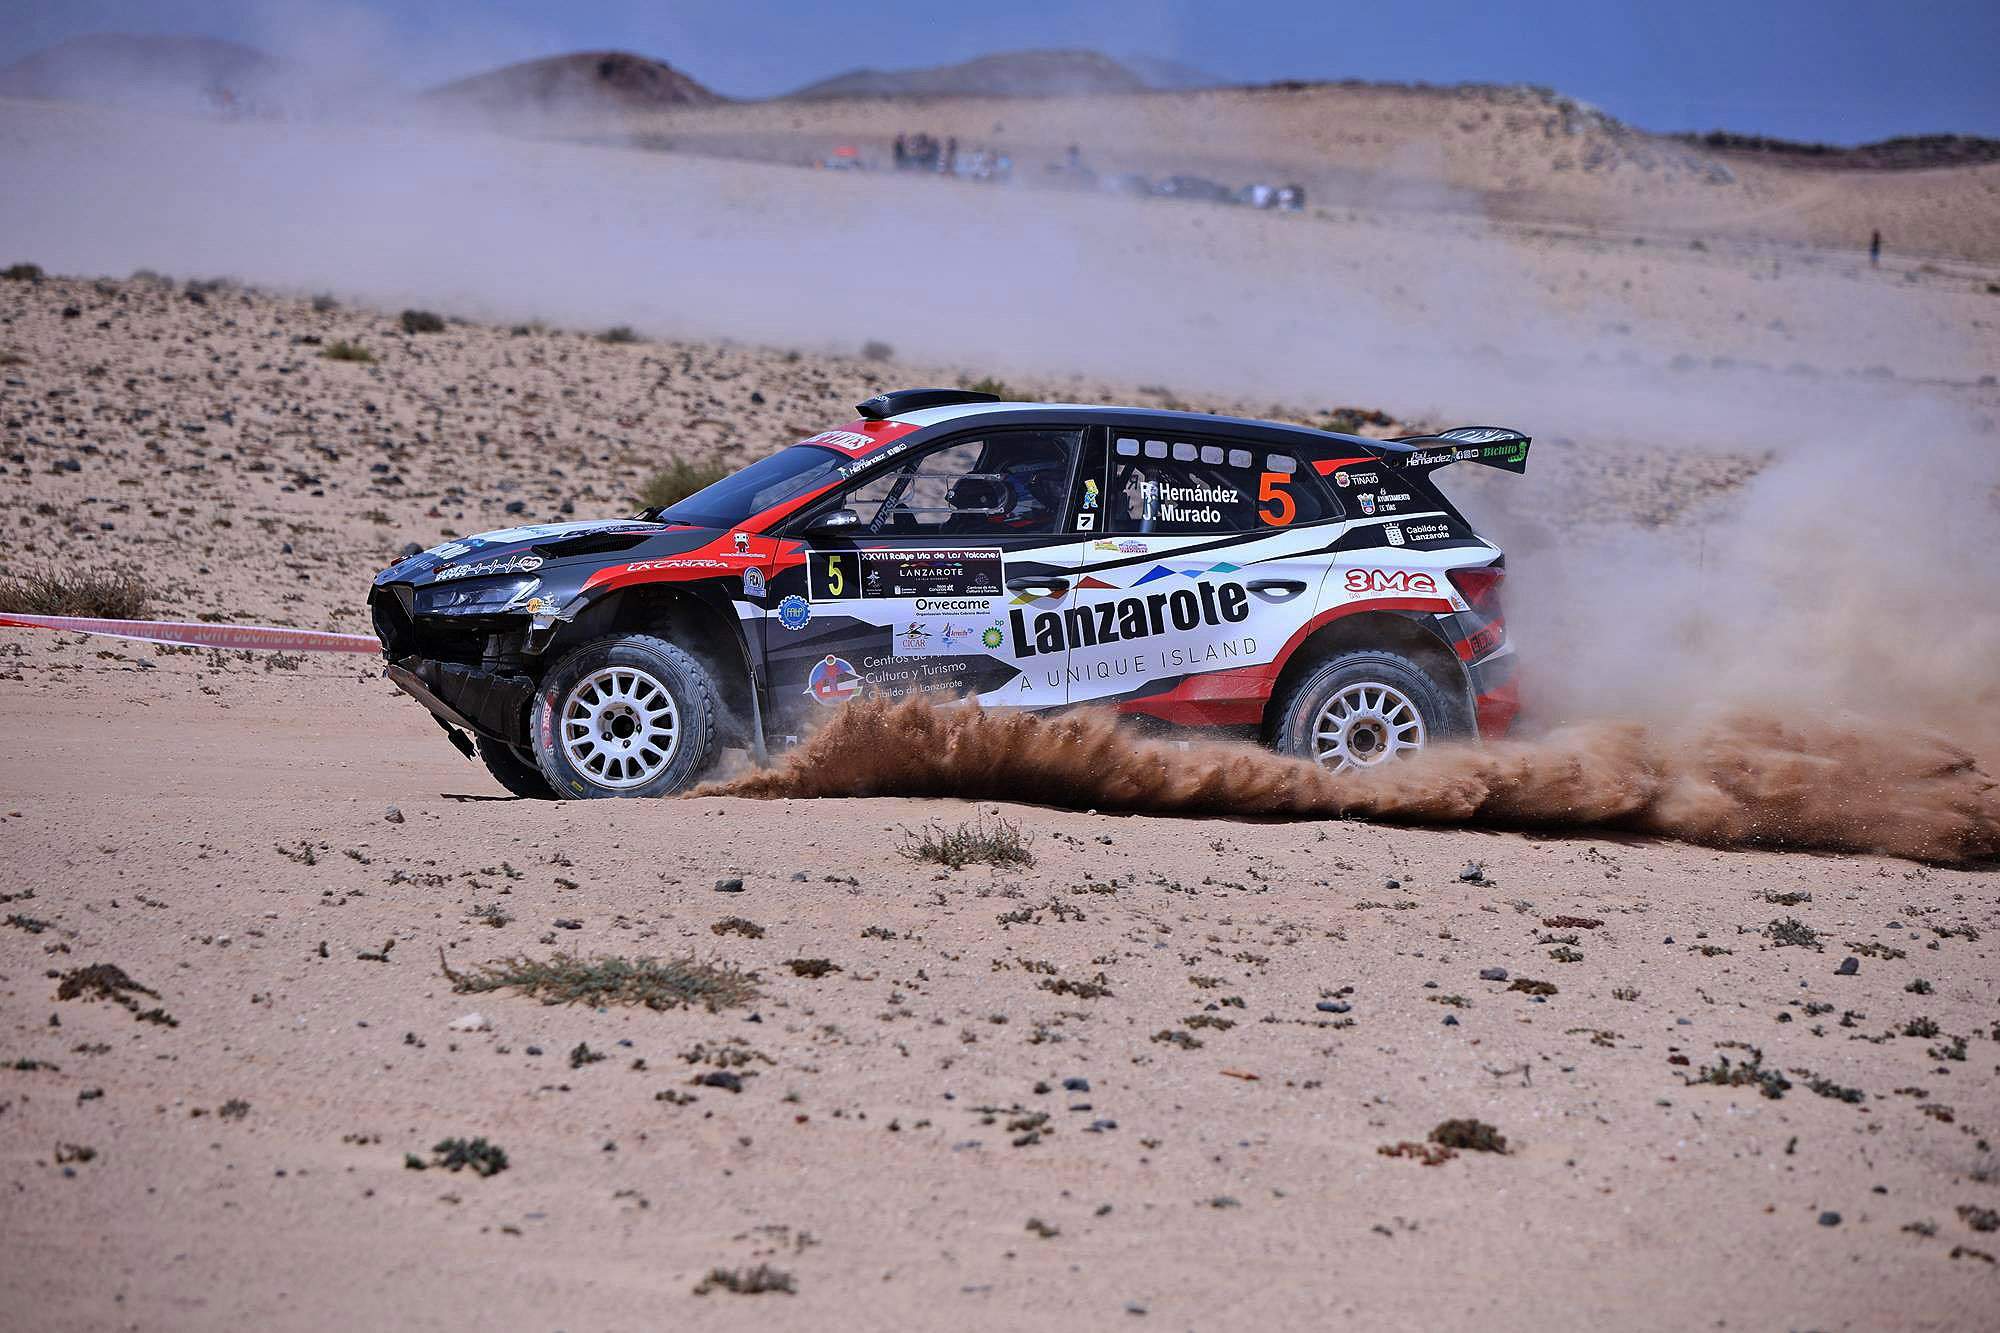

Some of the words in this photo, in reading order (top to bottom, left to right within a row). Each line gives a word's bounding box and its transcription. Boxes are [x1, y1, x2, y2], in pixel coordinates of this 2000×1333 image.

[1406, 455, 1451, 467] Hernández
[1351, 476, 1379, 486] TINAJO
[1140, 482, 1155, 500] R.
[1160, 483, 1239, 503] Hernández
[1258, 472, 1296, 527] 5
[1143, 504, 1156, 521] J.
[1161, 504, 1221, 523] Murado
[1406, 524, 1437, 534] Cabildo
[1411, 532, 1450, 541] Lanzarote
[889, 552, 915, 561] Rallye
[947, 551, 961, 559] Los
[964, 551, 1000, 559] Volcanes
[829, 555, 844, 596] 5
[899, 568, 964, 577] LANZAROTE
[915, 598, 990, 610] Orvecame
[995, 618, 1004, 627] bp
[1009, 580, 1250, 659] Lanzarote
[863, 656, 909, 668] Centros
[1020, 676, 1033, 692] A
[1047, 655, 1146, 687] UNIQUE
[1162, 638, 1257, 668] ISLAND
[865, 670, 909, 684] Cultura
[912, 670, 919, 680] y
[920, 662, 967, 676] Turismo
[920, 679, 963, 693] Lanzarote
